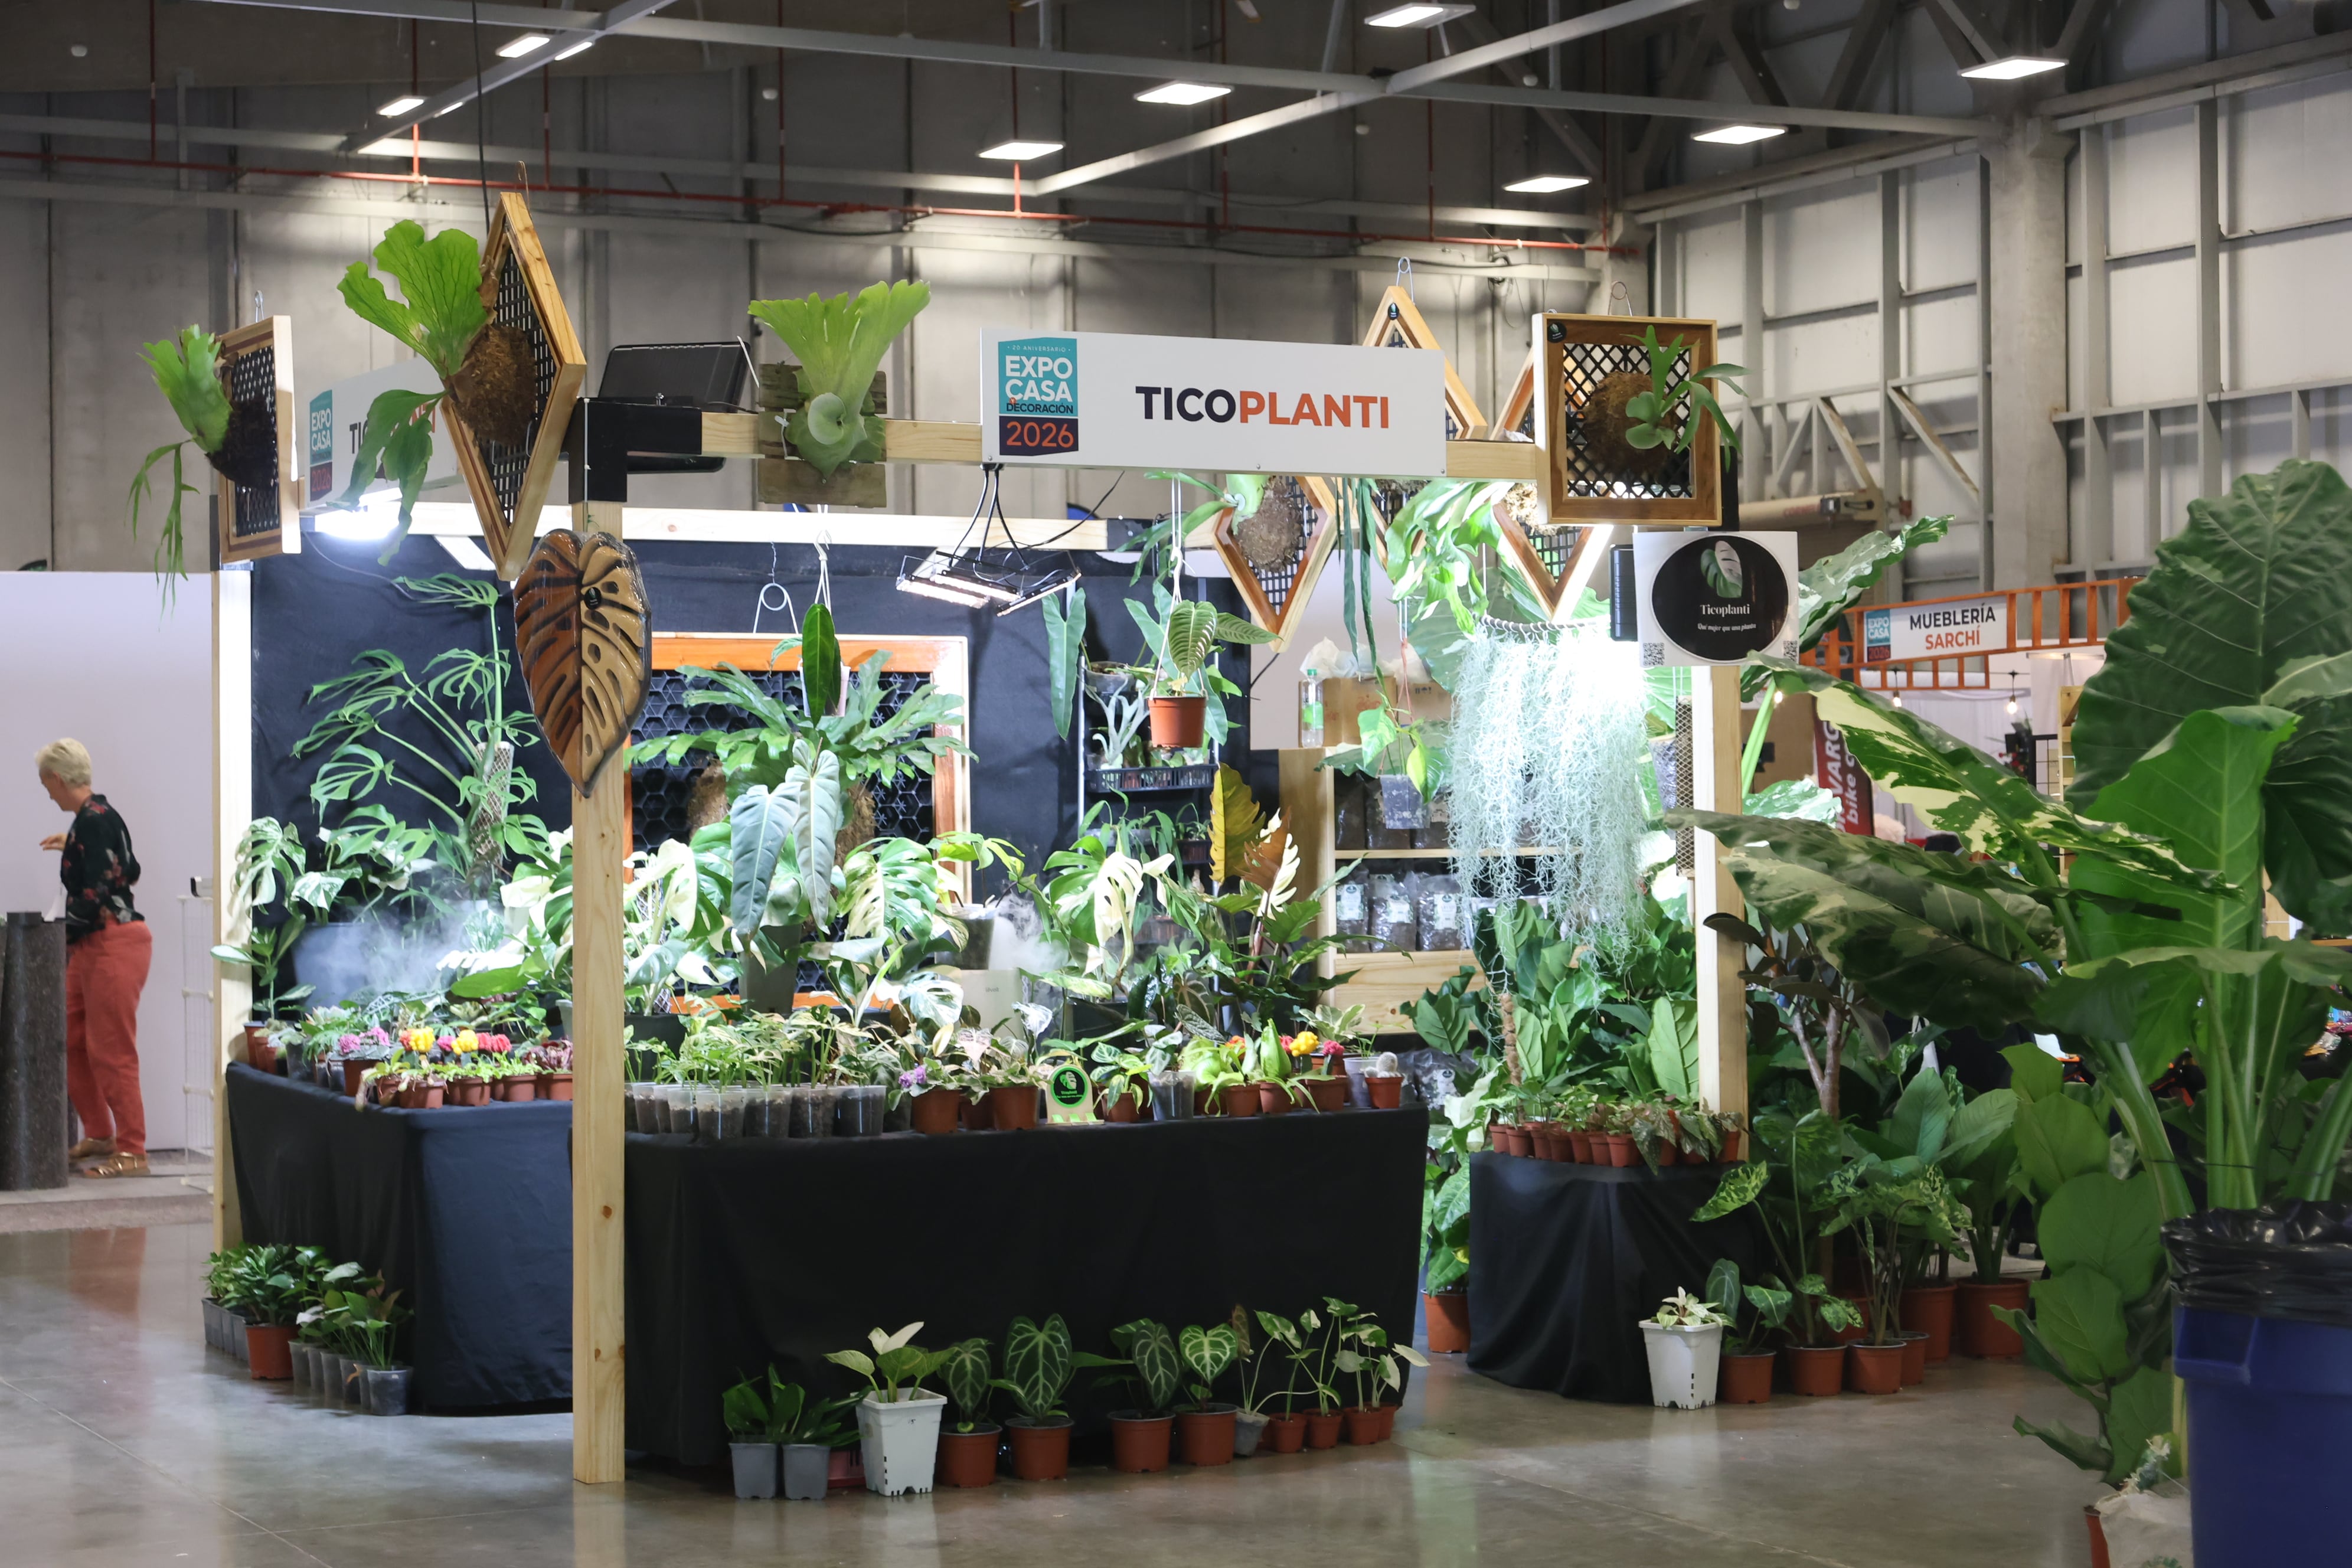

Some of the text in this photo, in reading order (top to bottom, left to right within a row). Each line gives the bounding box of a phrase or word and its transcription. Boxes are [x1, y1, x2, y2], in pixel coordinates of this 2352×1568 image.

[1023, 345, 1066, 353] ANIVERSARIO
[1005, 355, 1073, 380] EXPO
[1005, 378, 1073, 402] CASA
[311, 407, 332, 432] EXPO
[1006, 403, 1074, 414] DECORACIÓN
[1135, 386, 1389, 429] TICOPLANTI
[311, 429, 332, 450] CASA
[1006, 420, 1074, 448] 2026
[311, 468, 332, 492] 2026
[1700, 603, 1750, 618] Ticoplanti
[1868, 616, 1889, 629] EXPO
[1910, 602, 1996, 631] MUEBLERÍA
[1868, 628, 1890, 639] CASA
[1925, 625, 1980, 651] SARCHÍ
[1868, 646, 1890, 659] 2026
[1845, 773, 1859, 825] bike
